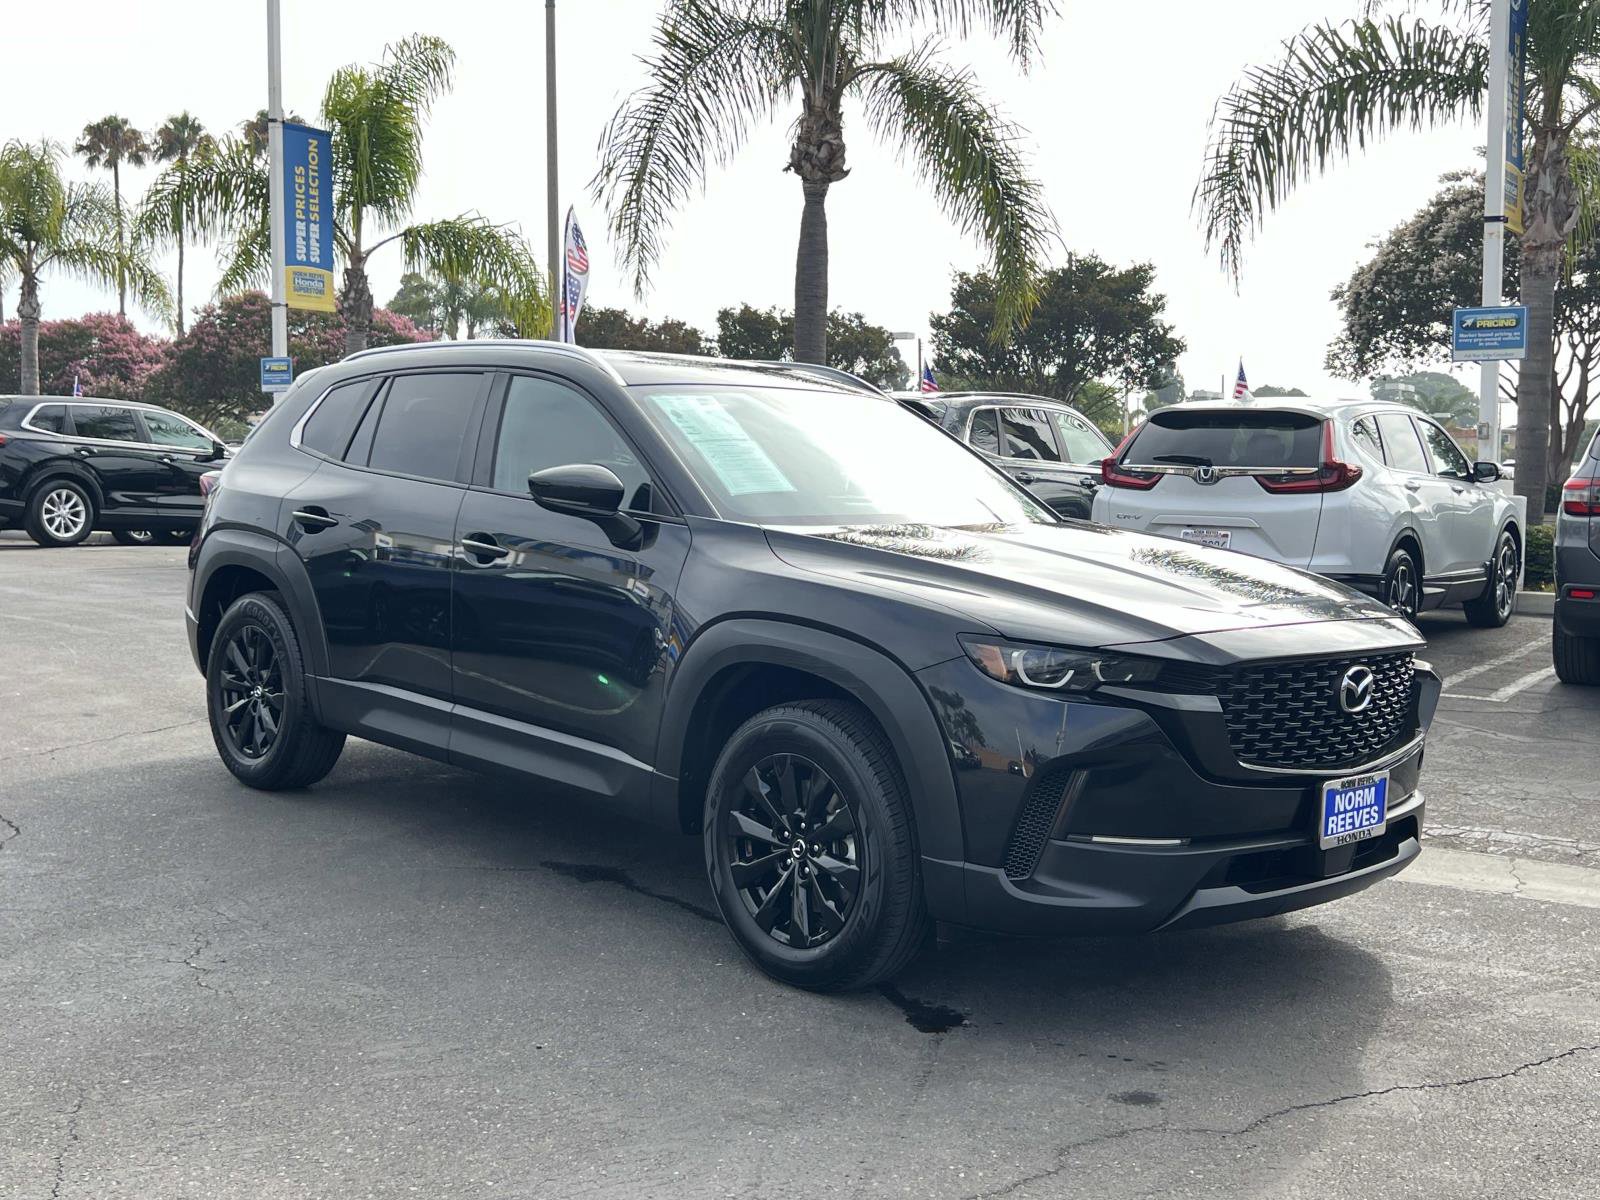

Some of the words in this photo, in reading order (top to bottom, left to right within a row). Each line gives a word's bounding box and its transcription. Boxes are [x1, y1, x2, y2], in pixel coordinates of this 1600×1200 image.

[1512, 31, 1520, 158] EXPERIENCE
[294, 165, 305, 219] PRICES
[308, 139, 320, 222] SELECTION
[296, 221, 307, 261] SUPER
[309, 223, 321, 263] SUPER
[295, 277, 323, 289] Honda
[1476, 319, 1517, 328] PRICING
[1334, 786, 1376, 814] NORM
[1327, 805, 1379, 835] REEVES
[1336, 828, 1373, 845] HONDA
